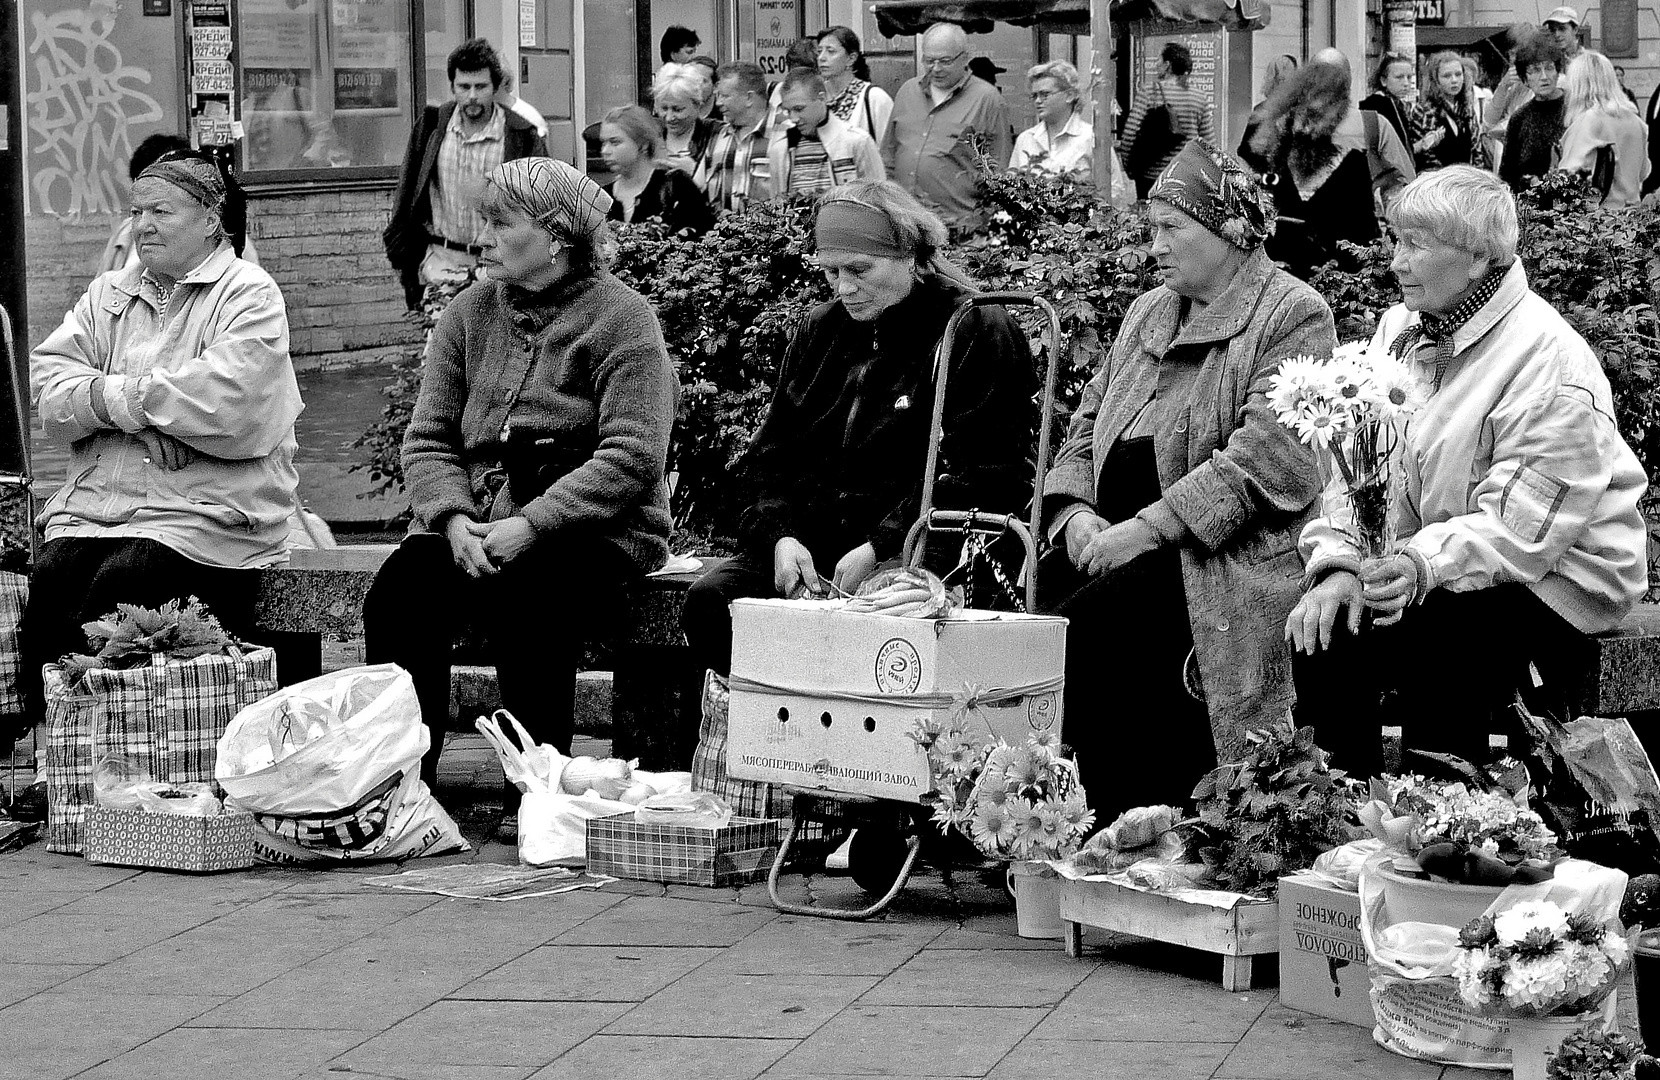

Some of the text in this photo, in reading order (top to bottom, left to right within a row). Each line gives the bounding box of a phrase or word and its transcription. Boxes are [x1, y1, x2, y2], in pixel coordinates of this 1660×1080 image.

[1416, 0, 1443, 19] ТЫ
[194, 33, 230, 42] КРЕДИТ
[1189, 49, 1214, 57] ОНОВ
[195, 67, 231, 75] КРЕДИТ
[741, 754, 918, 788] МЯСОПЕРЕРАБВАЮЩИЙ ЗАВОД
[1296, 902, 1361, 932] ОРОЖЕНОЕ
[1295, 931, 1369, 967] ЕТРОХОЛОД
